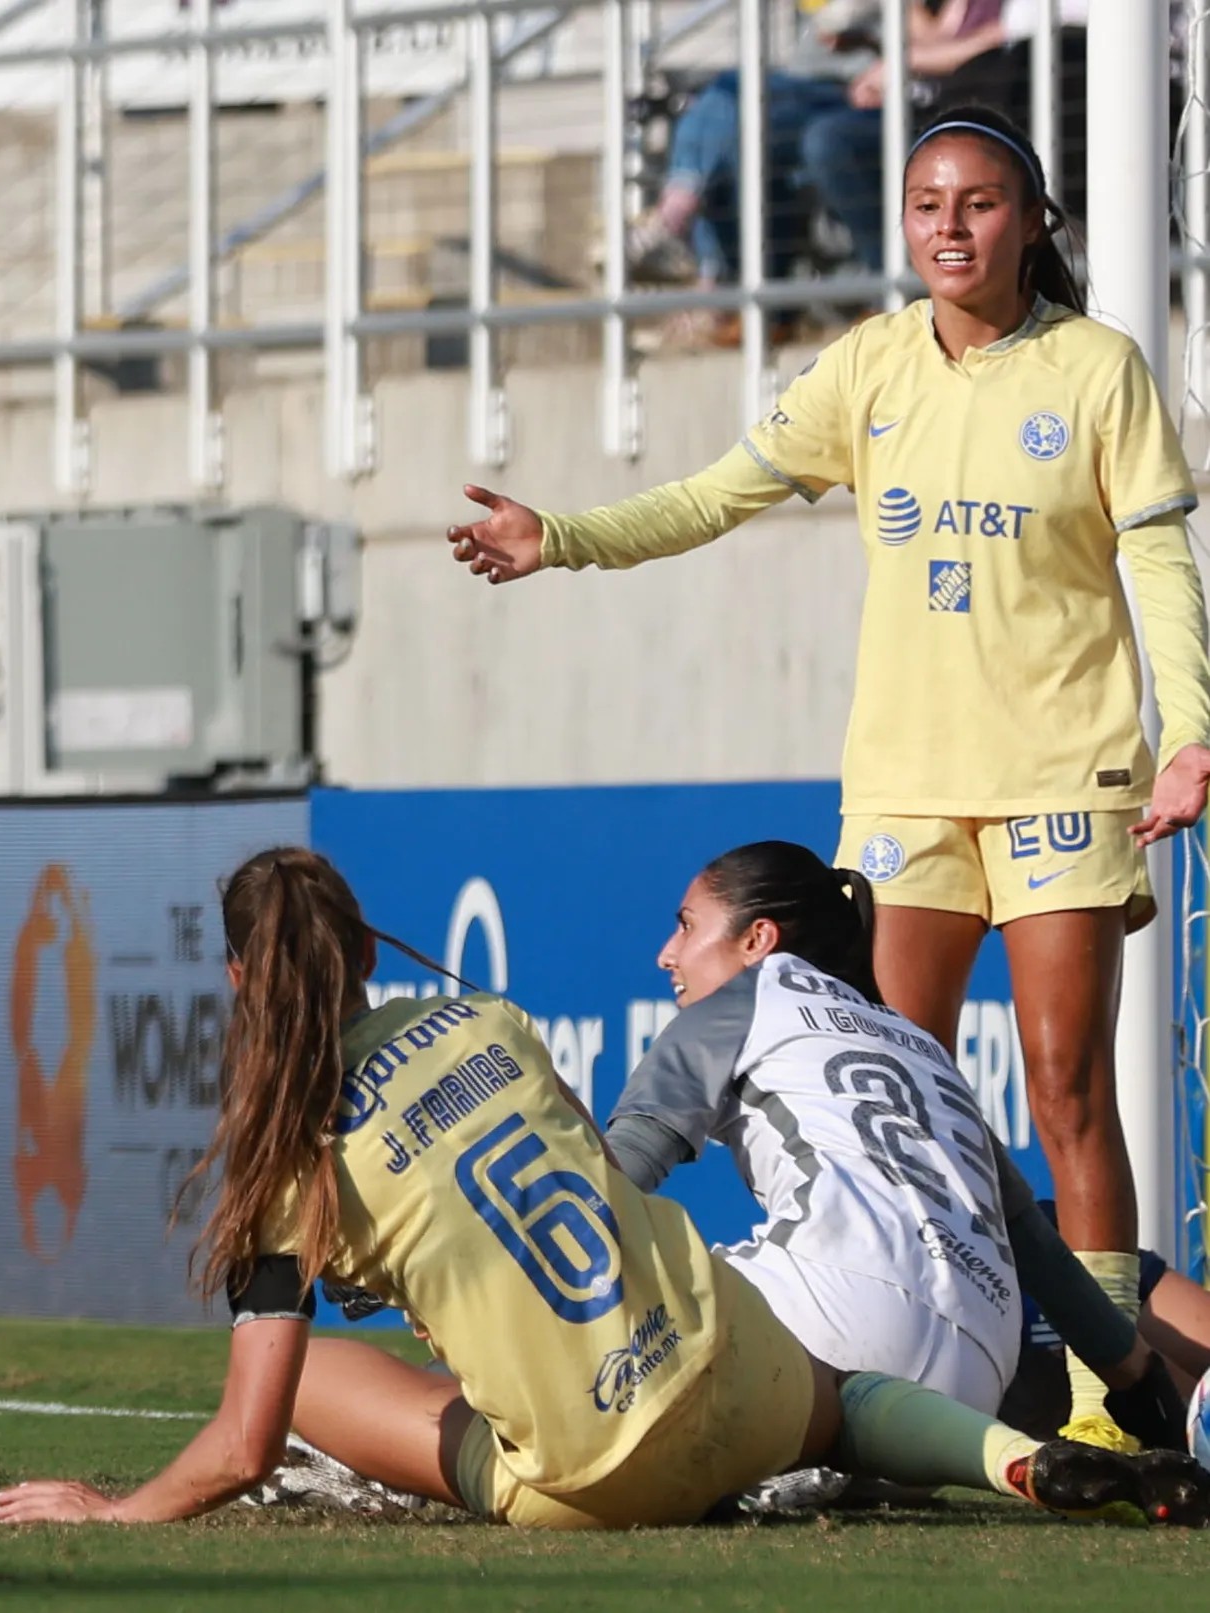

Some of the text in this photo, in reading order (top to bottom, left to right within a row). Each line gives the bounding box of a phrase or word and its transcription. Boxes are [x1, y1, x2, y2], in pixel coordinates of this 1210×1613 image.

[934, 499, 1032, 540] AT&T
[337, 1002, 480, 1134] Corona
[455, 1112, 624, 1325] 6
